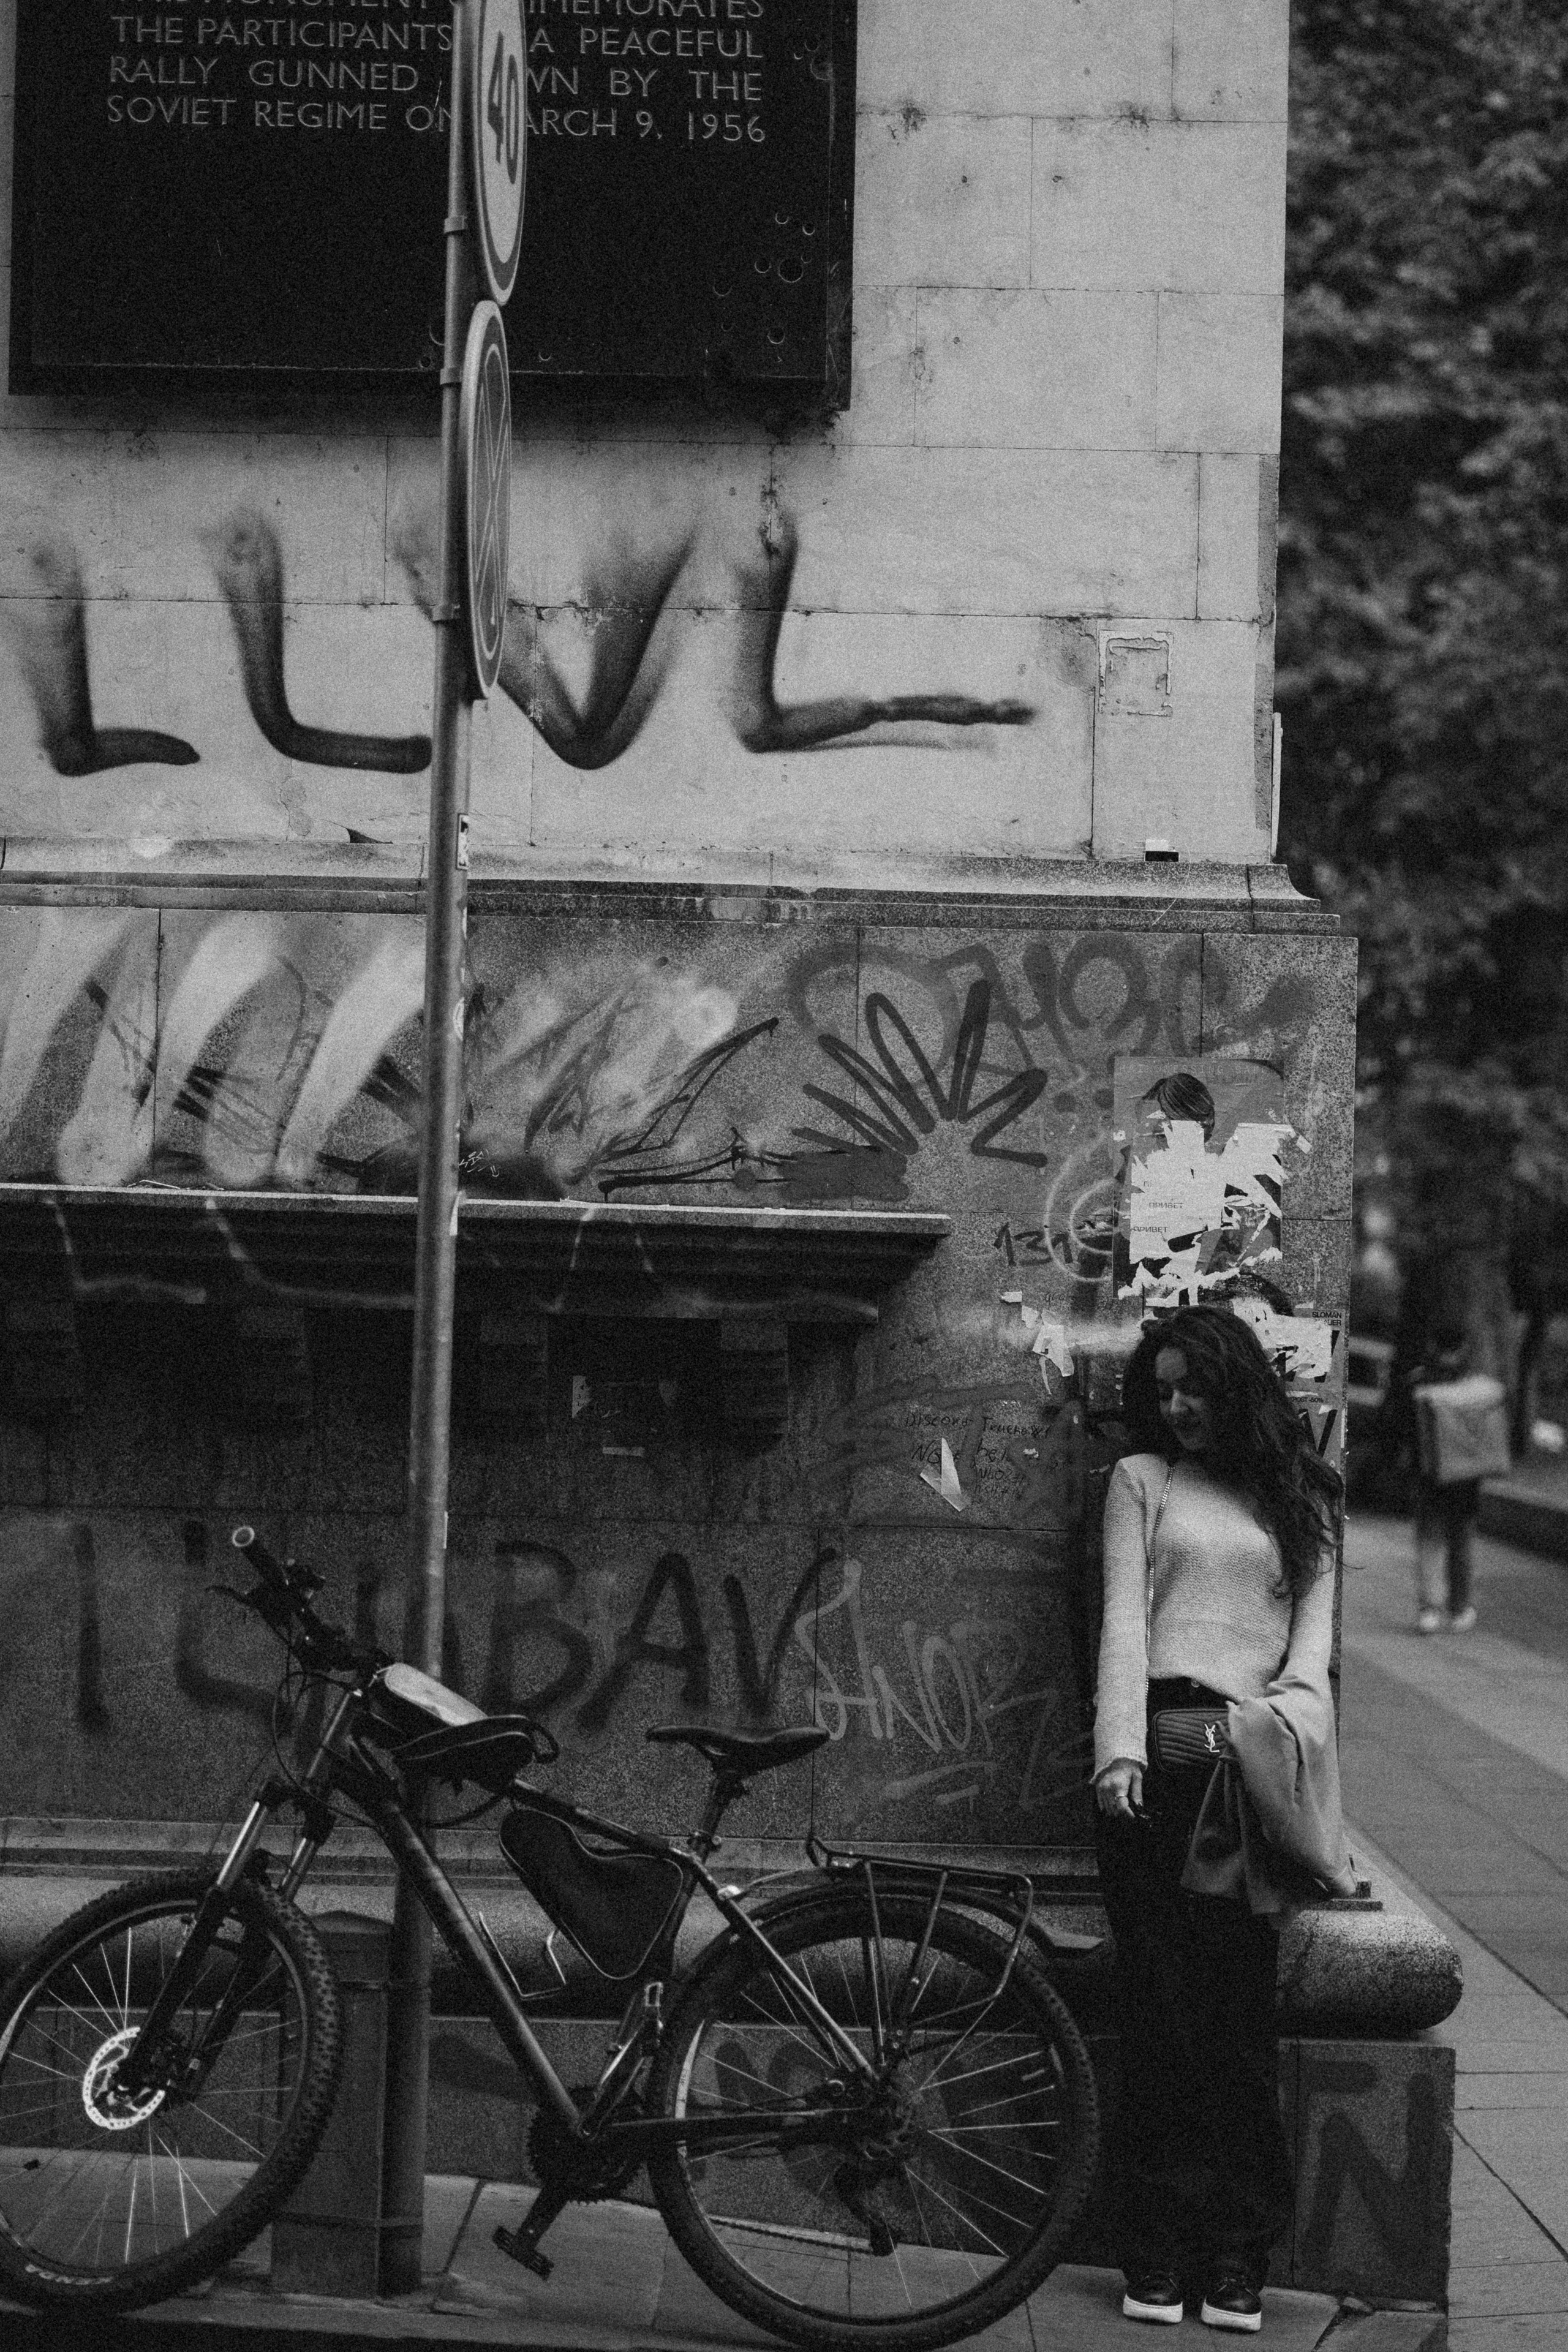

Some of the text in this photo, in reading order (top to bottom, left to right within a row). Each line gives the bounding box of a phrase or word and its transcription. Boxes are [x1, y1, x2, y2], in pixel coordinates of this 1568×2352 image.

[110, 16, 764, 58] THE PARTICIPANTS A PEACEFUL
[110, 56, 219, 85] RALLY
[248, 59, 419, 91] GUNNED
[610, 68, 658, 97] BY
[688, 69, 762, 101] THE
[107, 95, 237, 126] SOVIET
[255, 100, 387, 130] REGIME
[688, 111, 766, 143] 1956
[488, 30, 519, 184] 40
